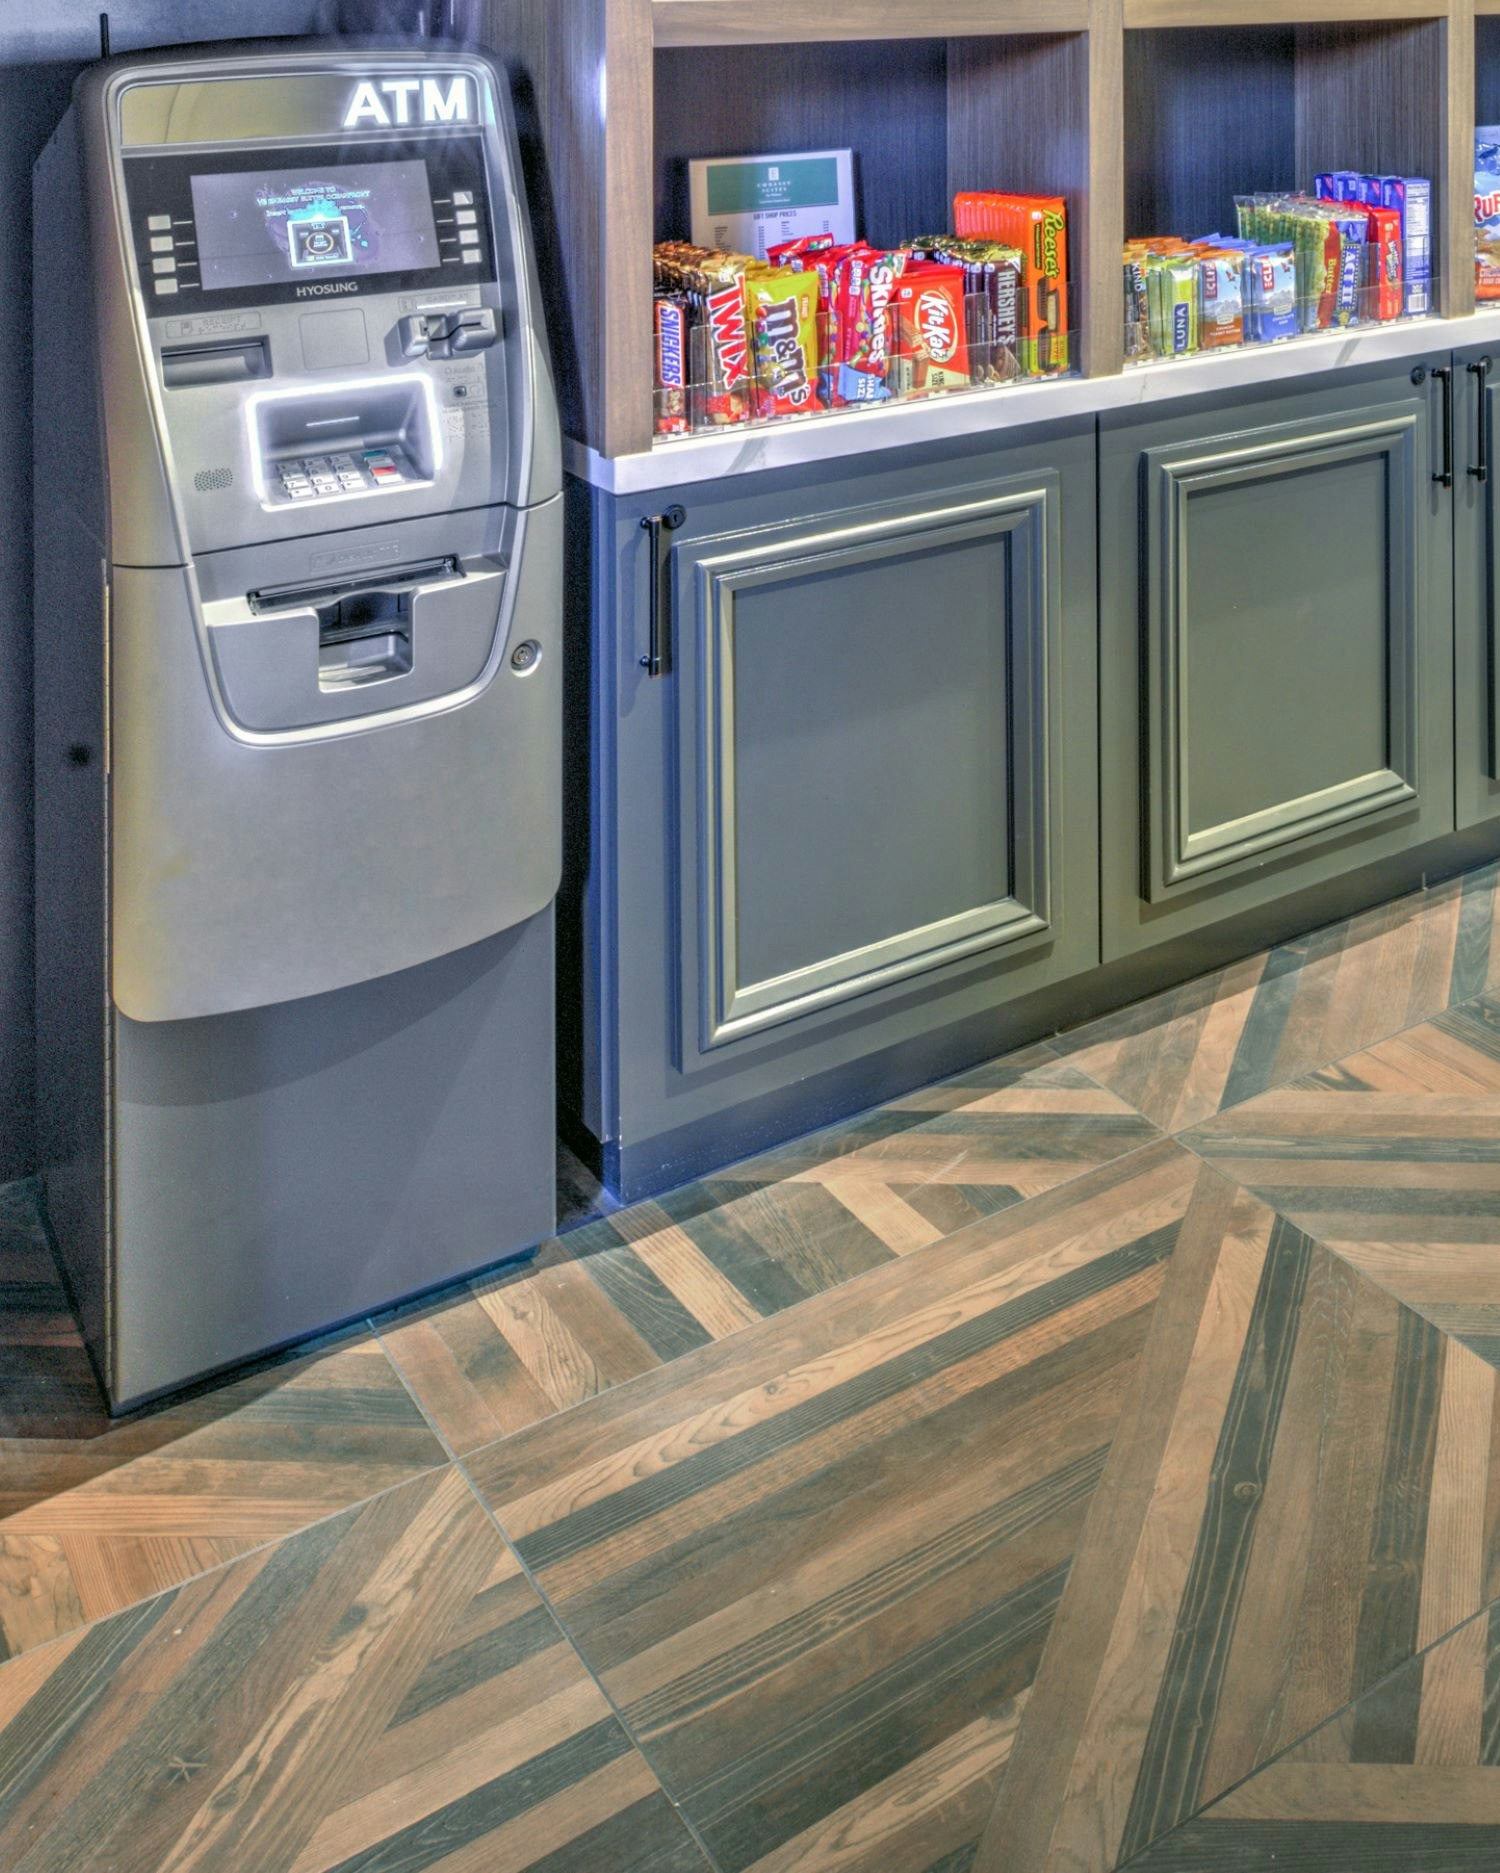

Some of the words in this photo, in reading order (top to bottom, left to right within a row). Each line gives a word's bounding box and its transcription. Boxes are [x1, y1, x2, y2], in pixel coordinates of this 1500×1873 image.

[344, 79, 469, 127] ATM
[766, 211, 778, 219] SHOP
[779, 210, 797, 218] PRICES
[1042, 208, 1065, 278] Reese's
[296, 281, 358, 297] HYOSUNG
[1132, 262, 1144, 292] KIND
[708, 273, 748, 390] TWIX
[997, 271, 1017, 346] HERSHEY'S
[1176, 306, 1187, 349] LUNA
[660, 307, 681, 385] SNICKERS
[766, 296, 810, 405] m&m's
